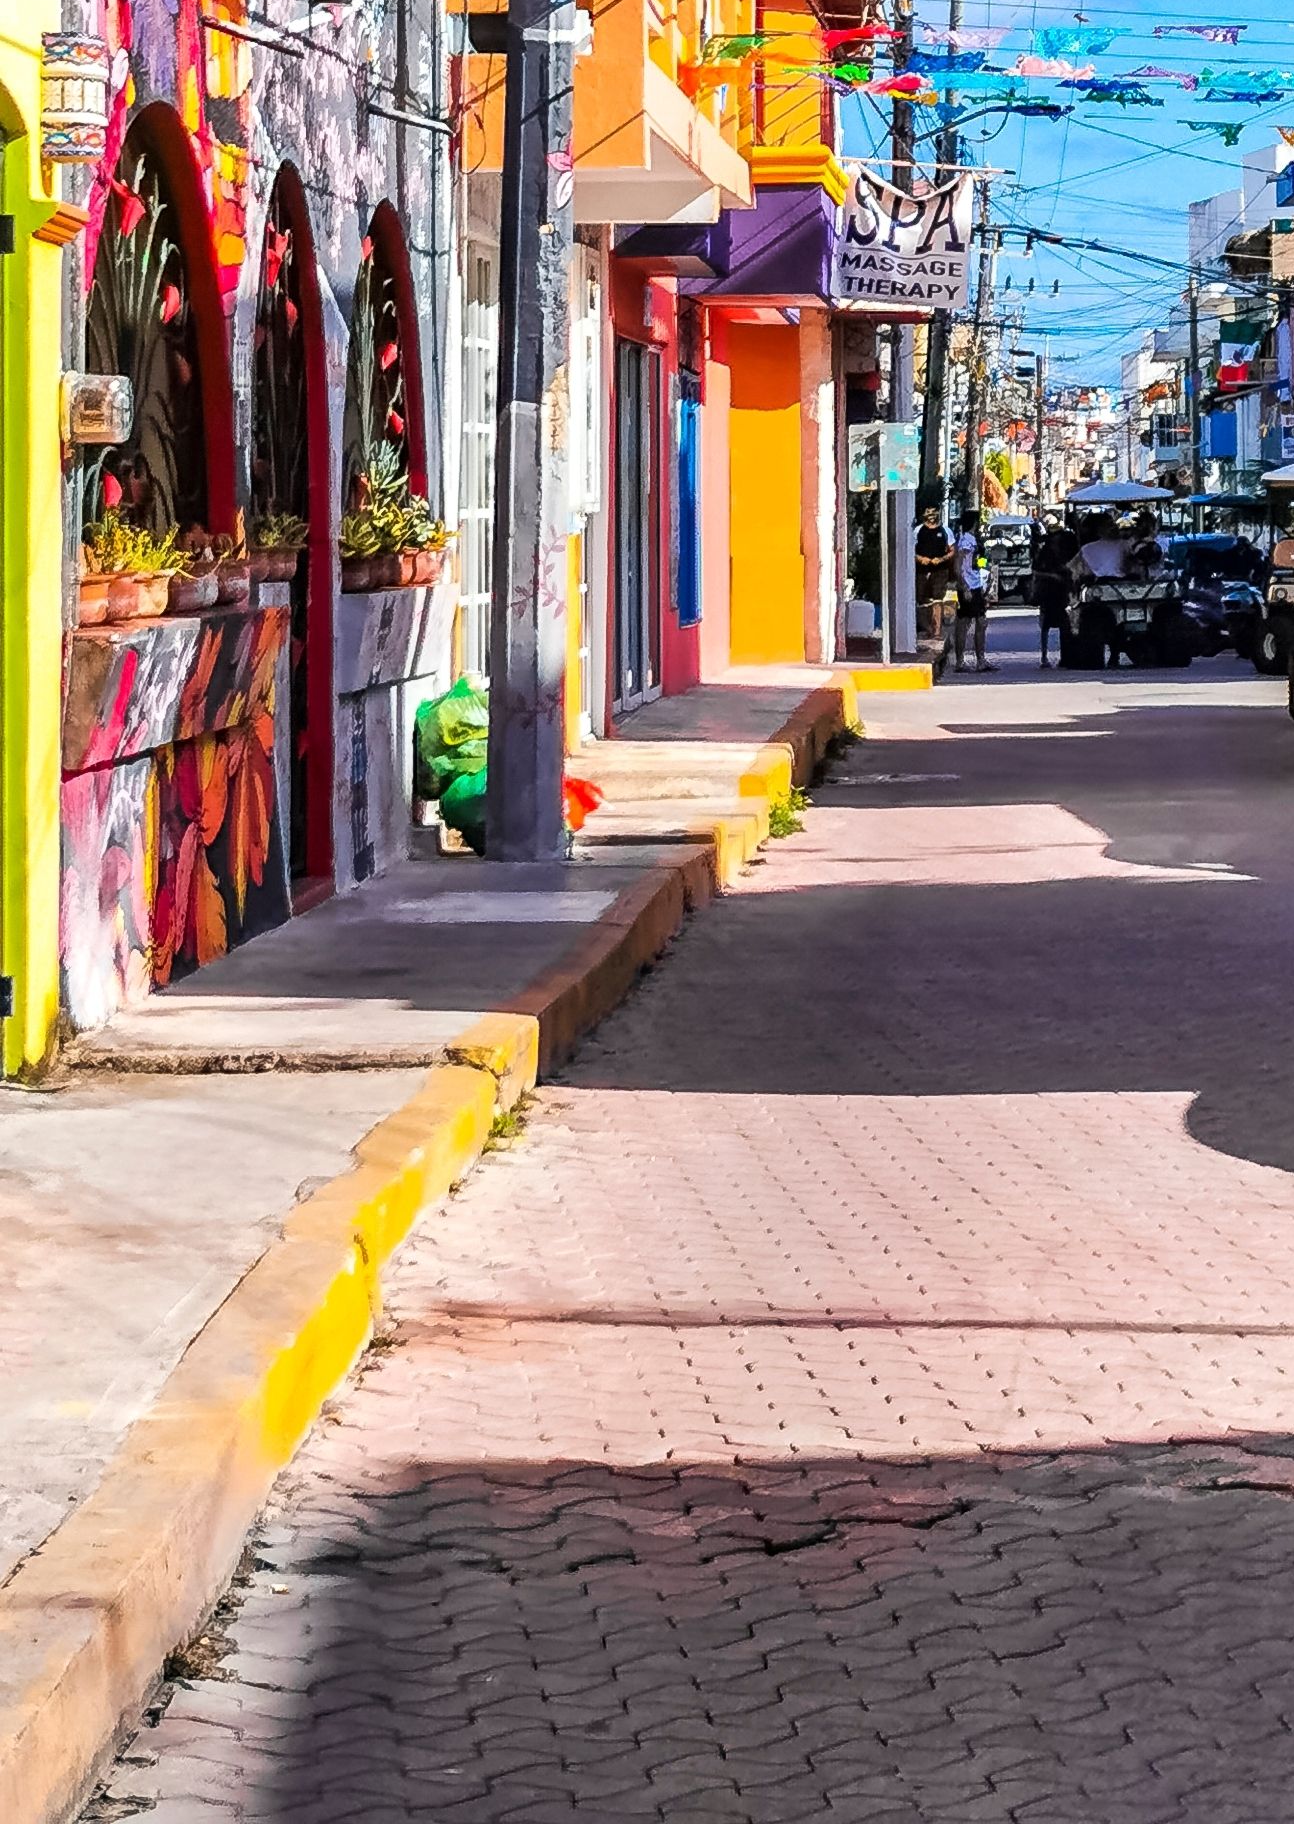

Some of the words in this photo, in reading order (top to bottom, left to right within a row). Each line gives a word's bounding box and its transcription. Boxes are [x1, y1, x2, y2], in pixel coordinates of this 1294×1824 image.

[846, 173, 965, 255] SPA
[840, 252, 963, 277] MASSAGE
[844, 276, 961, 300] THERAPY
